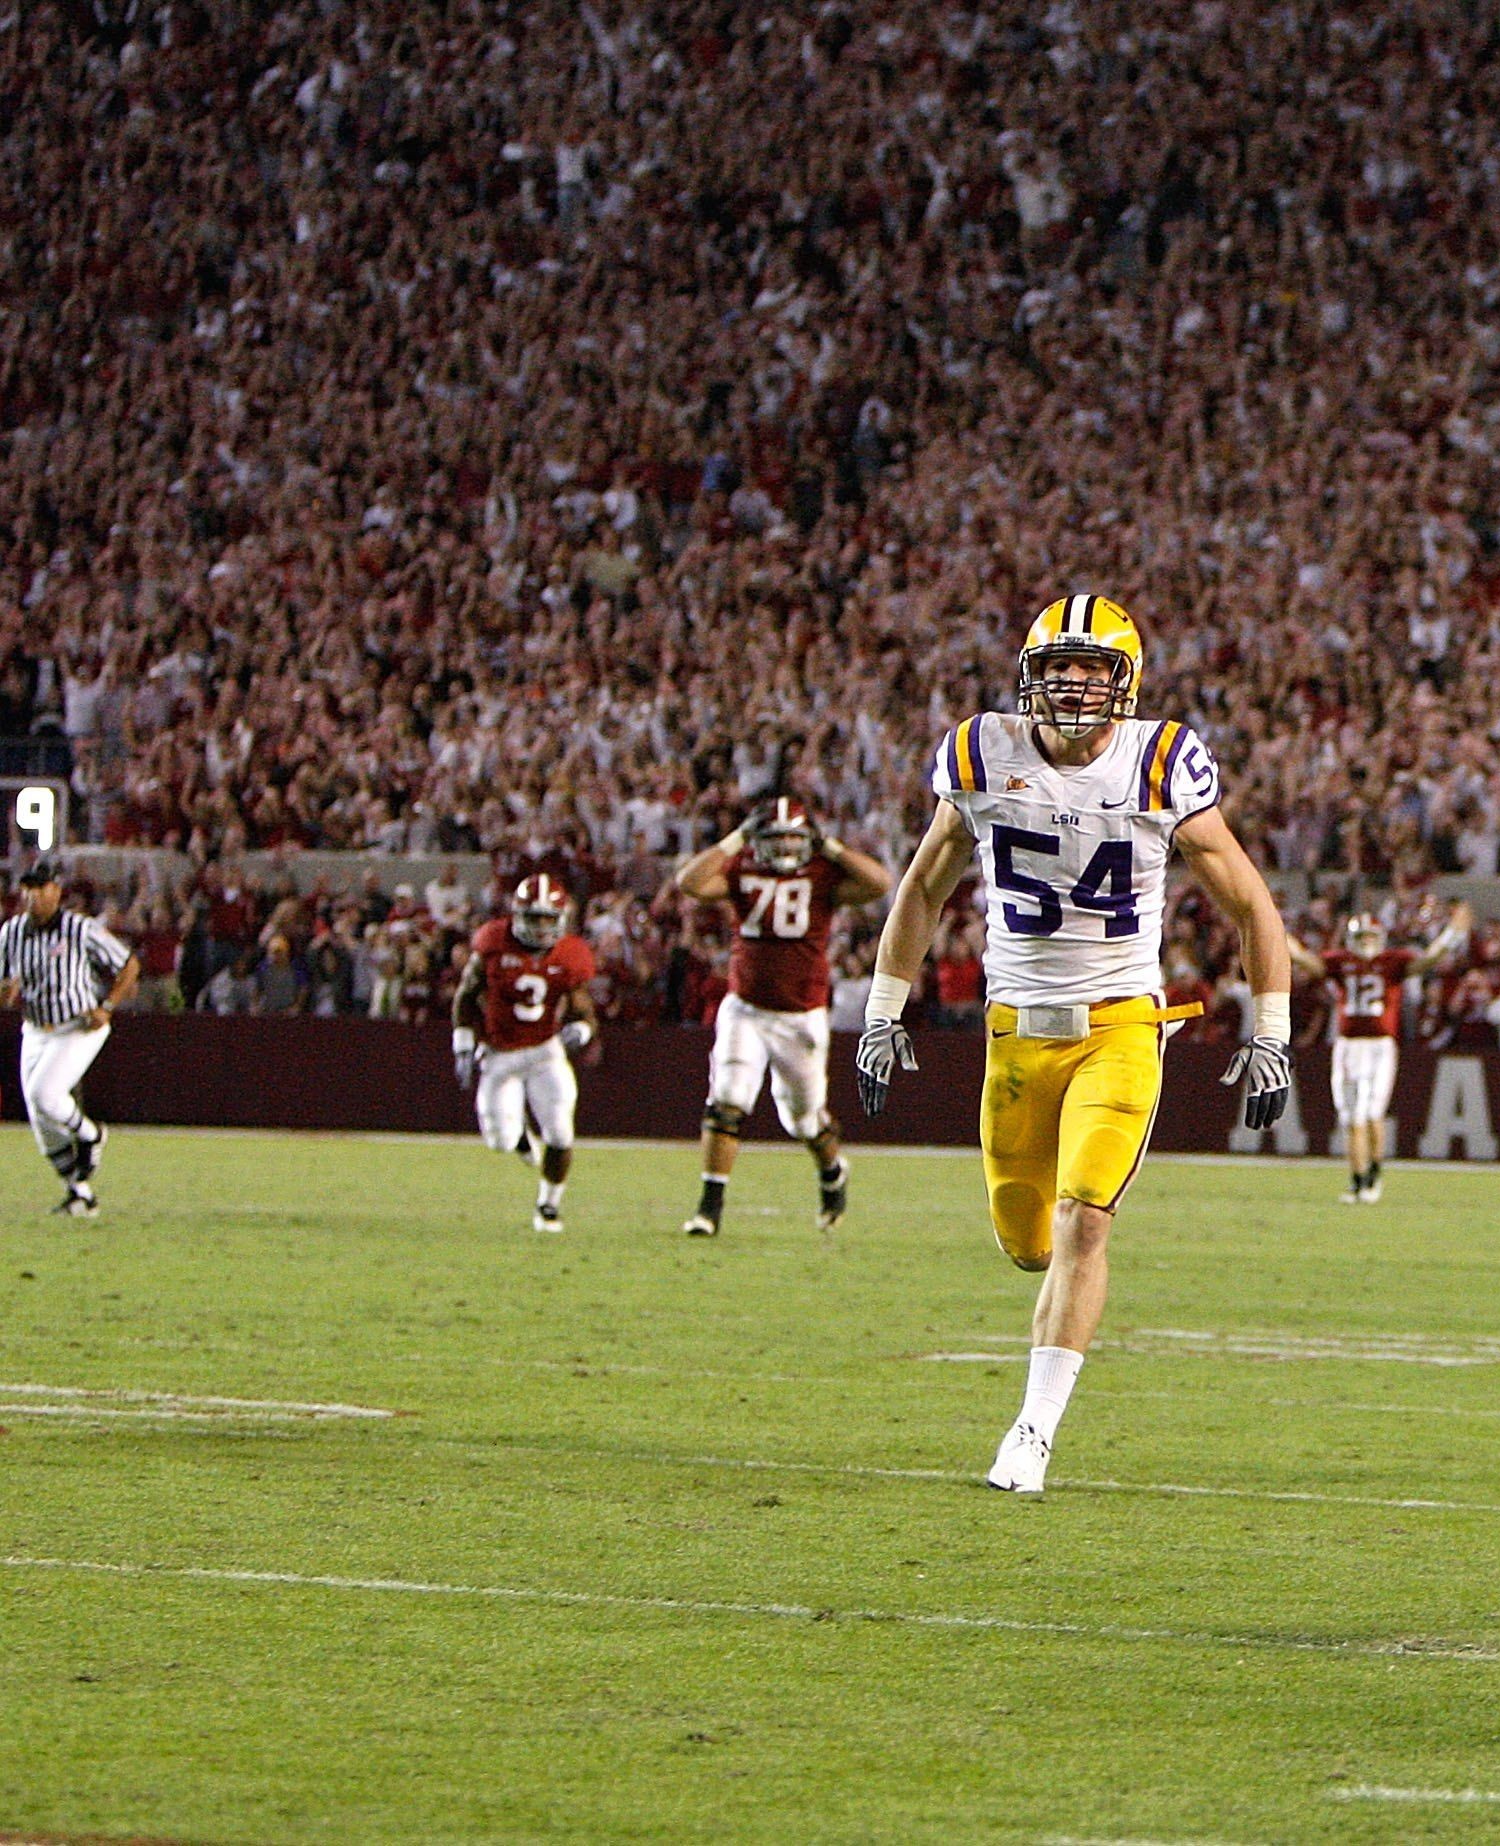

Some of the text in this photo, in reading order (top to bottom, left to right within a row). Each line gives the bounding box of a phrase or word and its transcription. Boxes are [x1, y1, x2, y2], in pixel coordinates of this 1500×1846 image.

[16, 786, 55, 851] 9
[1051, 813, 1080, 826] LSU
[739, 875, 813, 939] 78
[991, 823, 1140, 939] 54
[513, 974, 548, 1021] 3
[1344, 974, 1385, 1017] 12
